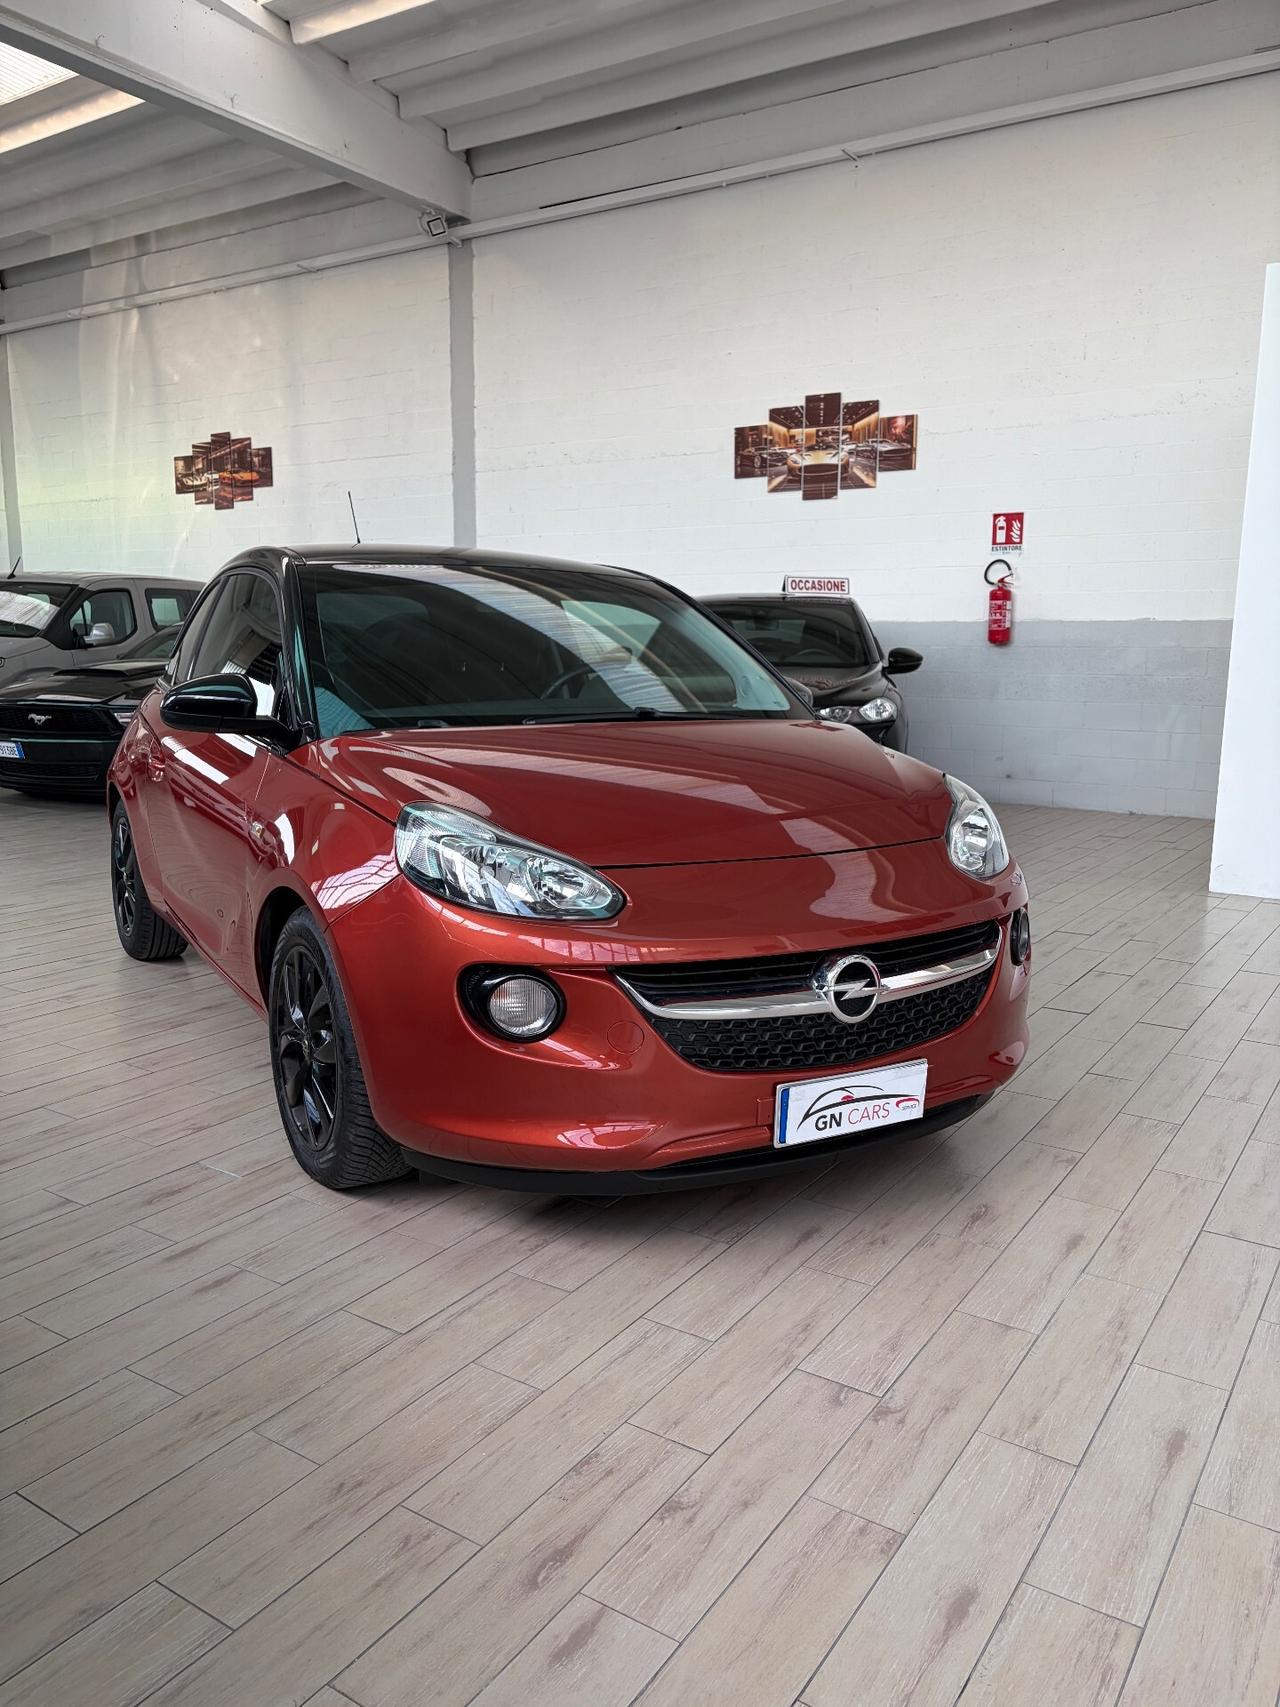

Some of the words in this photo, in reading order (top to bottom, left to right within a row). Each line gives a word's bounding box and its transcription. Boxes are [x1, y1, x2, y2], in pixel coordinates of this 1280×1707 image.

[790, 579, 846, 592] OCCASIONE
[815, 1112, 842, 1131] GN
[848, 1102, 890, 1125] CARS
